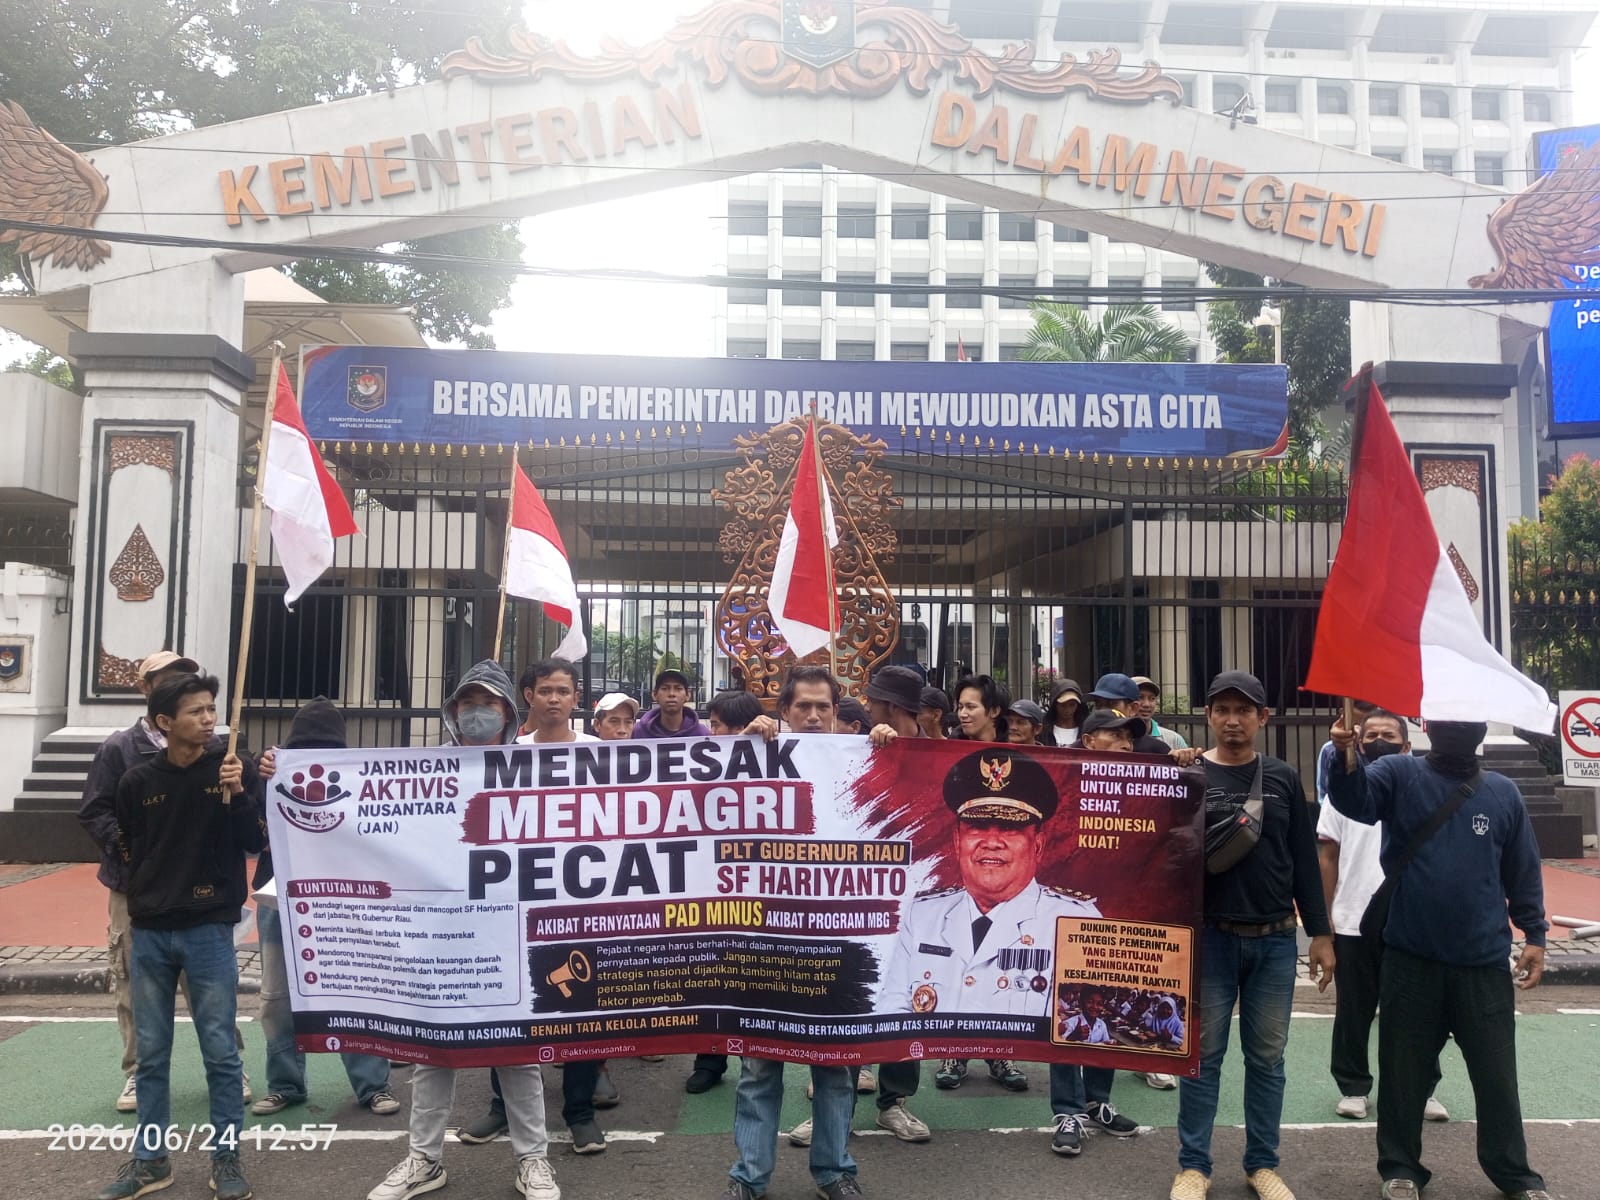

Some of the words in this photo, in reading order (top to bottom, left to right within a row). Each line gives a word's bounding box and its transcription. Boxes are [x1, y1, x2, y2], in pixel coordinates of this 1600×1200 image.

[218, 83, 701, 227] KEMENTERIAN
[931, 91, 1158, 199] DALAM
[1160, 150, 1387, 258] NEGERI
[433, 380, 572, 418] BERSAMA
[580, 385, 754, 424] PEMERINTAH
[881, 391, 1076, 428] MEWUJUDKAN
[1083, 393, 1152, 429] ASTA
[1160, 393, 1222, 429] CITA
[358, 758, 460, 776] JARINGAN
[484, 739, 800, 788] MENDESAK
[1081, 762, 1145, 778] PROGRAM
[1149, 765, 1179, 780] MBG
[359, 776, 459, 801] AKTIVIS
[1080, 780, 1122, 795] UNTUK
[1126, 783, 1188, 799] GENERASI
[357, 801, 456, 817] NUSANTARA
[488, 786, 796, 841] MENDAGRI
[1079, 798, 1121, 815] SEHAT,
[357, 821, 399, 836] (JAN)
[1079, 816, 1156, 833] INDONESIA
[1078, 834, 1120, 850] KUAT!
[720, 842, 753, 860] PLT
[760, 843, 858, 862] GUBERNUR
[863, 844, 905, 862] RIAU
[468, 841, 698, 902] PECAT
[296, 882, 353, 895] TUNTUTAN
[356, 884, 380, 896] JAN:
[717, 865, 750, 894] SF
[759, 866, 906, 897] HARIYANTO
[312, 902, 342, 911] Mendagri
[344, 904, 366, 912] segera
[367, 904, 411, 913] mengevaluasi
[413, 905, 426, 913] dan
[427, 906, 462, 915] mencopot
[464, 905, 475, 913] SF
[476, 904, 514, 914] Hariyanto
[327, 912, 351, 920] jabatan
[361, 914, 393, 922] Gubernur
[536, 917, 580, 936] AKIBAT
[584, 912, 660, 933] PERNYATAAN
[664, 902, 700, 929] PAD
[705, 900, 763, 927] MINUS
[765, 910, 805, 929] AKIBAT
[808, 912, 865, 930] PROGRAM
[867, 911, 890, 929] MBG
[375, 929, 401, 938] terbuka
[404, 930, 428, 940] kepada
[432, 931, 475, 941] masyarakat
[1080, 922, 1118, 934] DUKUNG
[1120, 925, 1167, 939] PROGRAM
[596, 945, 632, 956] Pejabat
[634, 944, 666, 954] negara
[668, 941, 694, 951] harus
[696, 939, 747, 949] berhati-hati
[749, 940, 775, 951] dalam
[776, 944, 842, 956] menyampaikan
[1067, 933, 1117, 946] STRATEGIS
[1119, 937, 1180, 953] PEMERINTAH
[317, 949, 355, 958] Mendorong
[394, 955, 435, 965] pengelolaan
[436, 956, 473, 965] keuangan
[474, 954, 502, 963] daerah
[596, 957, 650, 969] pernyataan
[652, 954, 686, 966] kepada
[688, 952, 720, 964] publik.
[722, 951, 757, 964] Jangan
[760, 955, 795, 966] sampai
[797, 958, 841, 969] program
[1082, 946, 1106, 958] YANG
[1109, 949, 1163, 963] BERTUJUAN
[352, 961, 392, 971] menimbulkan
[393, 964, 416, 974] polemik
[418, 967, 432, 975] dan
[433, 967, 475, 976] kegaduhan
[476, 965, 502, 976] publik.
[597, 968, 644, 981] strategis
[646, 965, 690, 978] nasional
[693, 963, 738, 976] dijadikan
[740, 966, 781, 980] kambing
[783, 968, 811, 980] hitam
[813, 972, 836, 981] atas
[1085, 958, 1159, 975] MENINGKATKAN
[320, 972, 358, 982] Mendukung
[360, 975, 380, 983] penuh
[381, 978, 406, 987] program
[408, 981, 436, 991] strategis
[438, 982, 481, 991] pemerintah
[483, 981, 503, 990] yang
[597, 982, 650, 996] persoalan
[653, 979, 681, 990] fiskal
[684, 977, 720, 988] daerah
[723, 979, 746, 991] yang
[748, 981, 789, 992] memiliki
[791, 984, 828, 997] banyak
[1064, 969, 1140, 985] KESEJAHTERAAN
[1142, 976, 1181, 989] RAKYAT!
[321, 982, 353, 991] bertujuan
[442, 992, 468, 1001] rakyat.
[597, 996, 628, 1007] faktor
[632, 992, 686, 1006] penyebab.
[327, 1016, 366, 1029] JANGAN
[368, 1019, 412, 1037] SALAHKAN
[415, 1026, 464, 1041] PROGRAM
[468, 1026, 527, 1040] NASIONAL,
[530, 1023, 572, 1038] BENAHI
[576, 1021, 602, 1033] TATA
[605, 1018, 647, 1031] KELOLA
[651, 1014, 699, 1028] DAERAH!
[739, 1017, 776, 1031] PEJABAT
[778, 1021, 806, 1034] HARUS
[808, 1023, 873, 1036] BERTANGGUNG
[874, 1020, 901, 1033] JAWAB
[902, 1019, 922, 1031] ATAS
[924, 1019, 955, 1030] SETIAP
[957, 1019, 1035, 1033] PERNYATAANNYA!
[344, 1039, 373, 1050] Jaringan
[394, 1048, 429, 1060] Nusantara
[560, 1044, 636, 1058] @aktivisnusantara
[748, 1044, 861, 1061] janusantara2024@gmail.com
[928, 1045, 1013, 1055] www.janusantara.or.id
